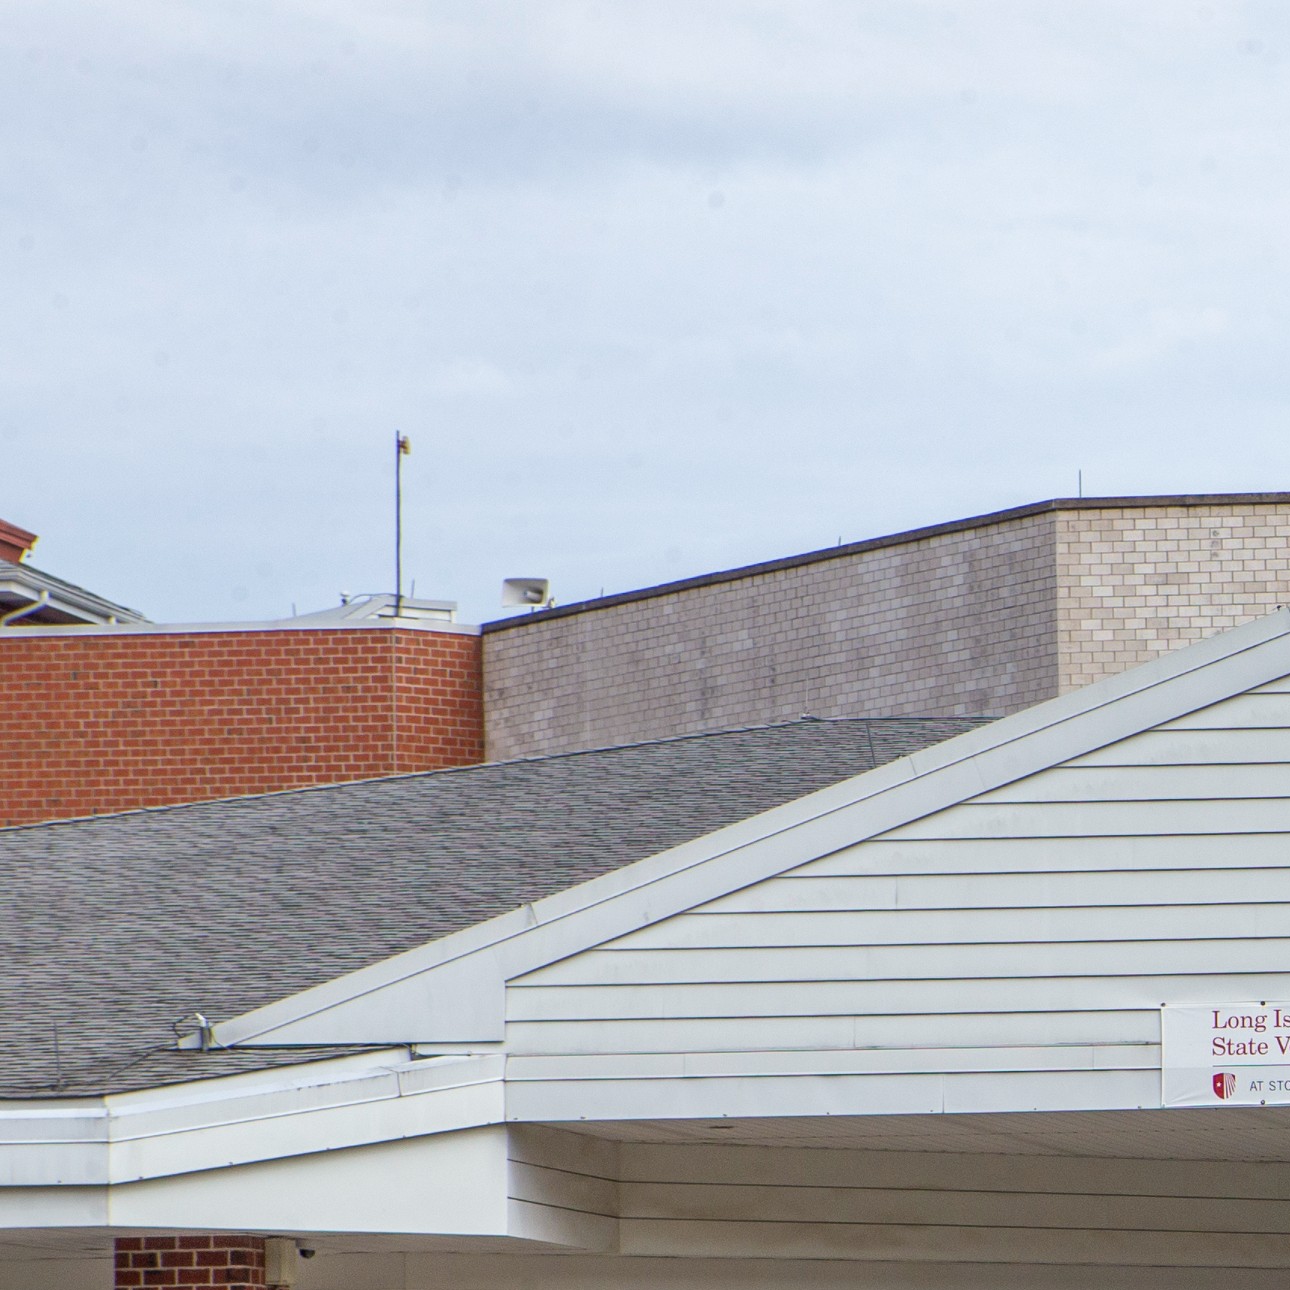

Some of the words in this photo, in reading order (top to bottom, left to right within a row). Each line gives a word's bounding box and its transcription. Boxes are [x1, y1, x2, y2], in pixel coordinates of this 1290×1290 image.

[1212, 1010, 1268, 1032] Long
[1212, 1036, 1269, 1056] State
[1250, 1081, 1264, 1091] AT
